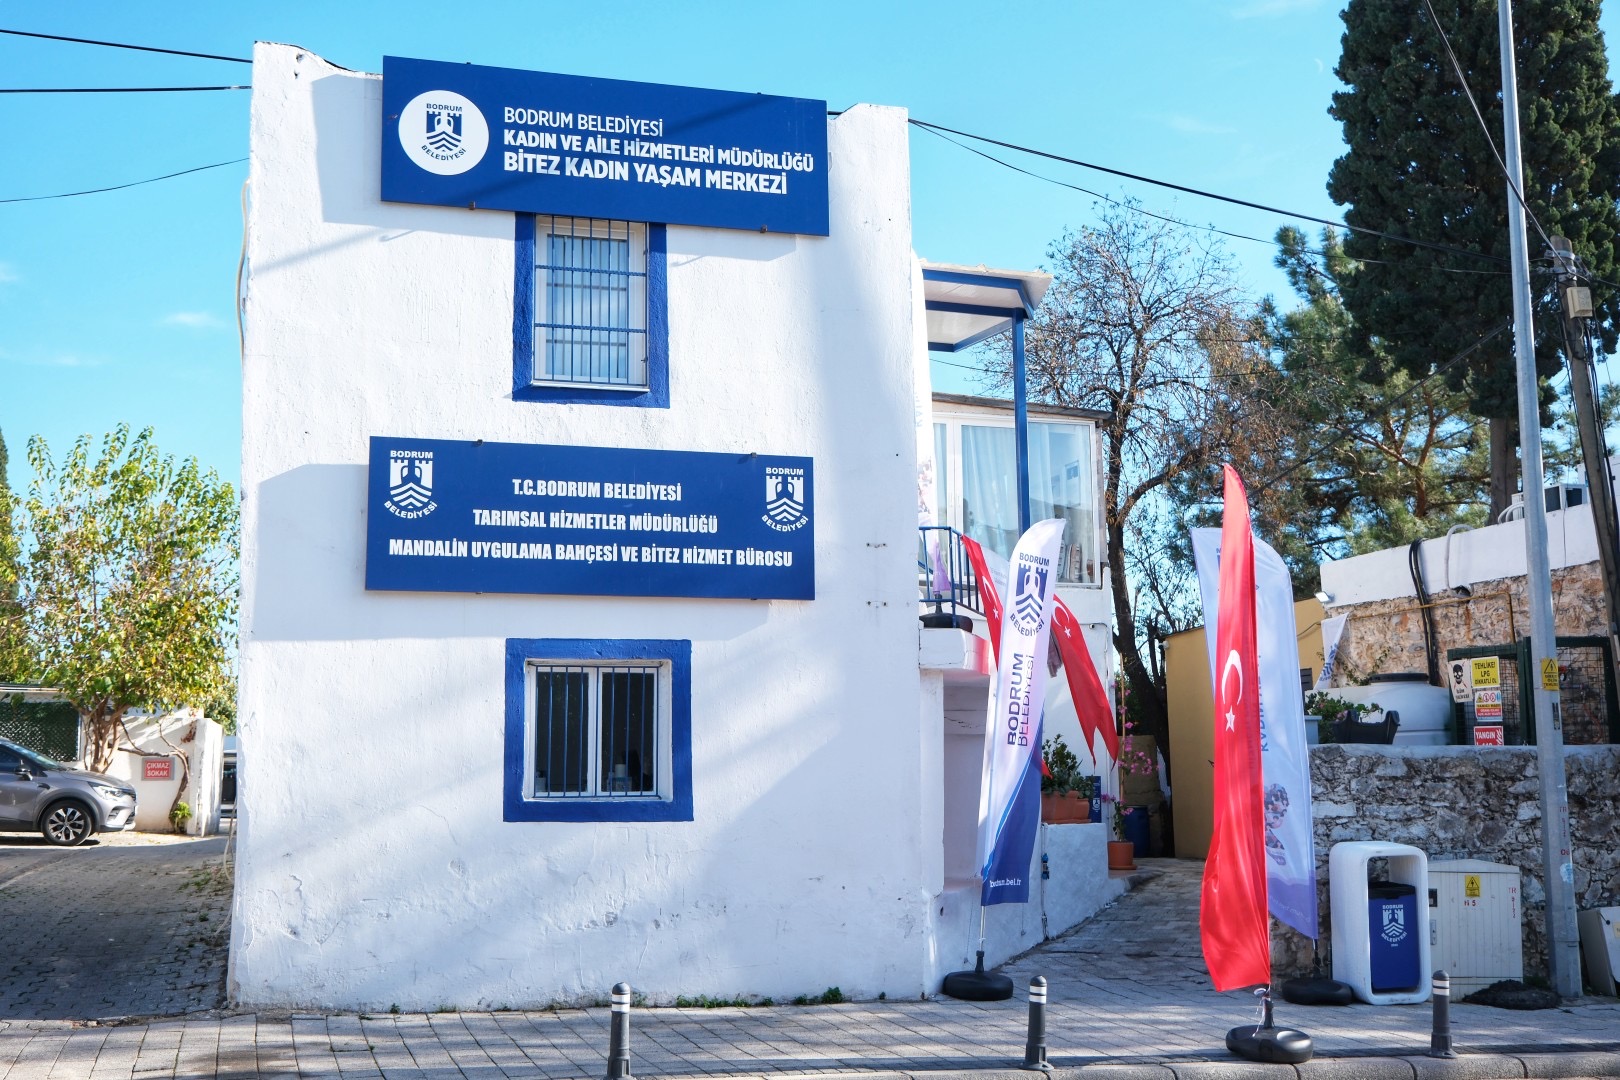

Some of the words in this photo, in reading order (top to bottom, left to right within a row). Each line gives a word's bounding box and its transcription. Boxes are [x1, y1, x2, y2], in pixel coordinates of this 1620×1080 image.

[426, 103, 463, 112] BODRUM
[504, 106, 573, 129] BODRUM
[577, 114, 663, 137] BELEDİYESİ
[503, 128, 557, 149] KADIN
[560, 134, 582, 151] VE
[585, 134, 621, 155] AİLE
[623, 137, 714, 164] HİZMETLERİ
[717, 146, 814, 172] MÜDÜRLÜĞÜ
[503, 149, 561, 175] BİTEZ
[565, 156, 629, 182] KADIN
[633, 162, 701, 188] YAŞAM
[705, 169, 788, 195] MERKEZİ
[390, 450, 433, 459] BODRUM
[765, 467, 804, 475] BODRUM
[603, 481, 682, 501] BELEDİYESİ
[384, 500, 438, 519] BELEDİYESİ
[472, 509, 547, 528] TARIMSAL
[549, 509, 627, 530] HİZMETLER
[629, 512, 718, 534] MÜDÜRLÜĞÜ
[761, 514, 809, 532] BELEDİYESİ
[389, 538, 468, 557] MANDALİN
[471, 541, 553, 560] UYGULAMA
[555, 543, 618, 564] BAHÇESİ
[620, 545, 639, 562] VE
[641, 543, 680, 564] BİTEZ
[682, 545, 733, 565] HİZMET
[735, 547, 793, 567] BÜROSU
[1019, 552, 1050, 567] BODRUM
[1007, 653, 1024, 746] BODRUM
[1017, 654, 1035, 747] BELEDİYESİ
[1475, 731, 1496, 739] YANGIN
[147, 762, 169, 770] ÇIKMAZ
